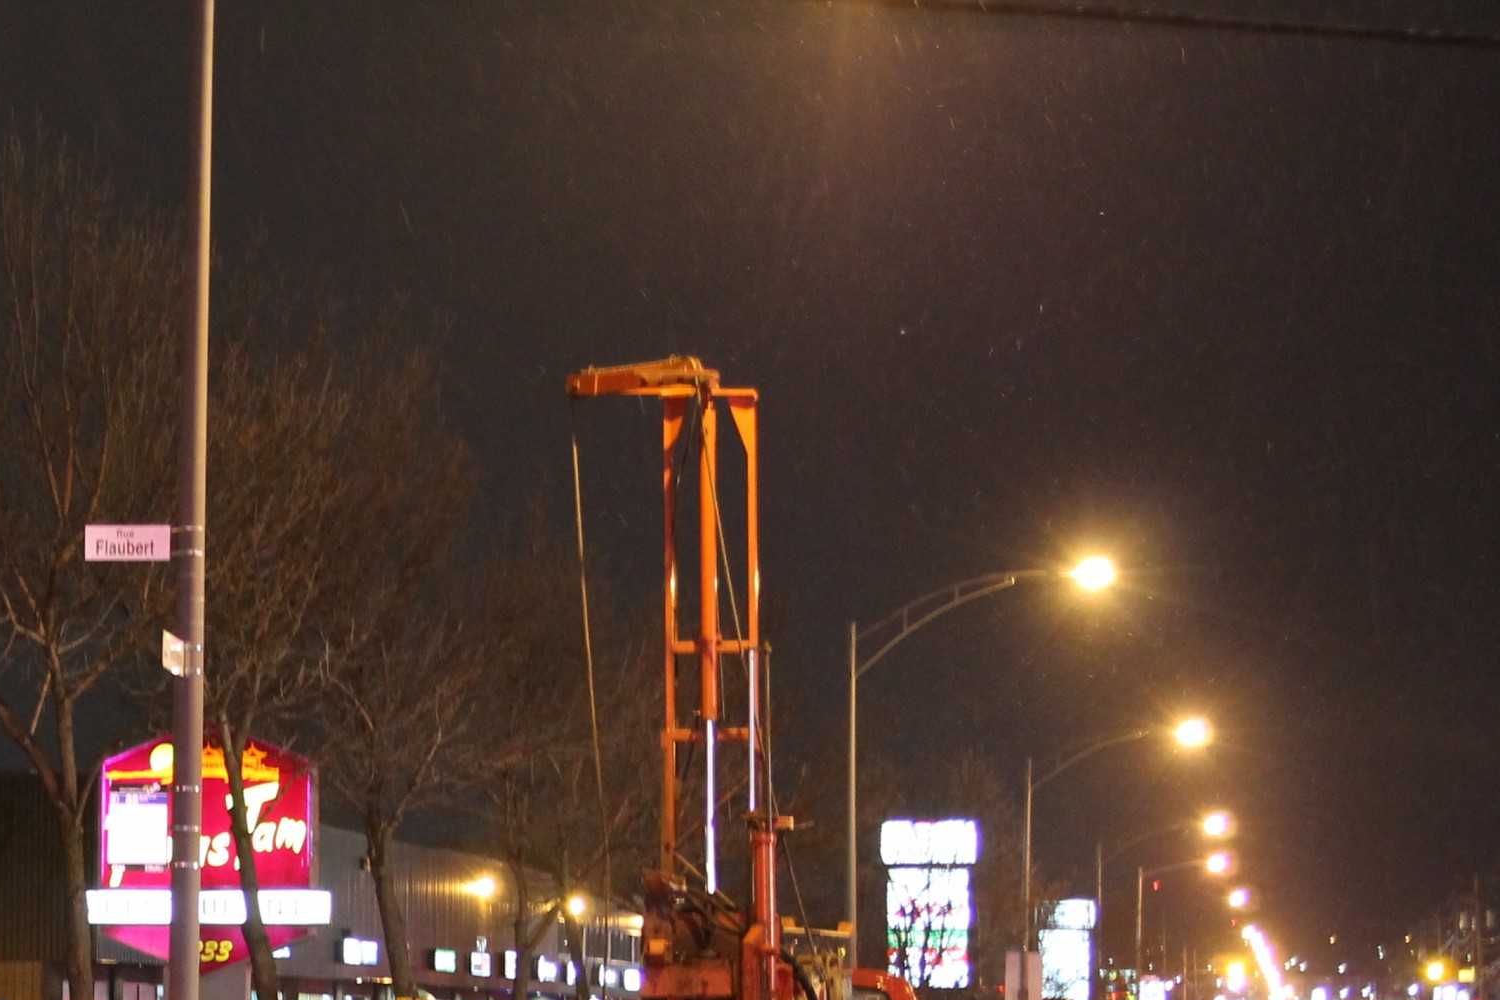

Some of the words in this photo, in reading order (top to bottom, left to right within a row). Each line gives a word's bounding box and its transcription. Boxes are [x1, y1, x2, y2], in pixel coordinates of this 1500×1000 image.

[116, 529, 135, 539] Rue
[94, 539, 154, 557] Flaubert
[225, 782, 308, 872] Tam
